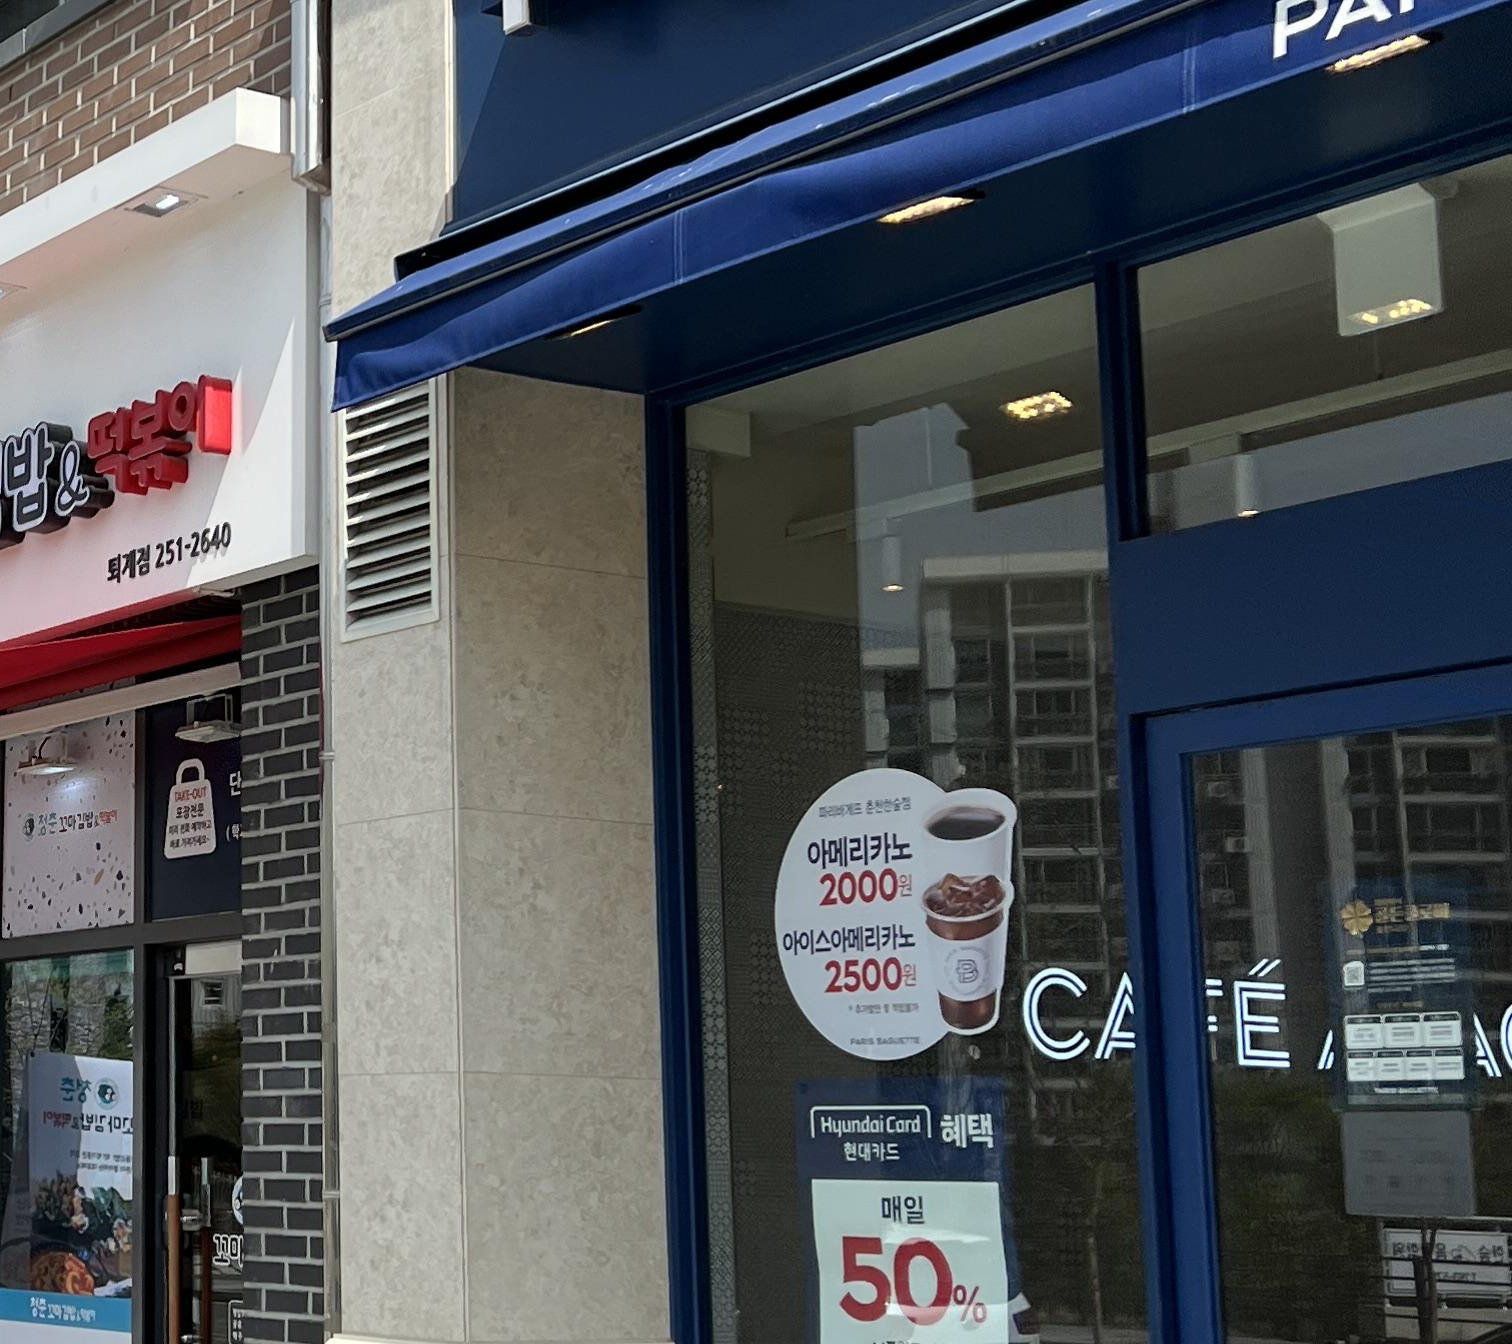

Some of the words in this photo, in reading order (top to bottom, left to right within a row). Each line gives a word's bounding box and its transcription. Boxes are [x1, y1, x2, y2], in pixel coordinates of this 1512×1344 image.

[155, 522, 231, 569] 251-2640
[807, 832, 912, 870] 아메리카노
[819, 868, 912, 906] 2000원
[783, 924, 916, 955] 아이스아메리카노
[824, 957, 916, 993] 2500원
[940, 1114, 994, 1148] 혜택
[844, 1142, 900, 1162] 현대카드
[881, 1195, 925, 1225] 매일
[840, 1236, 988, 1327] 50%
